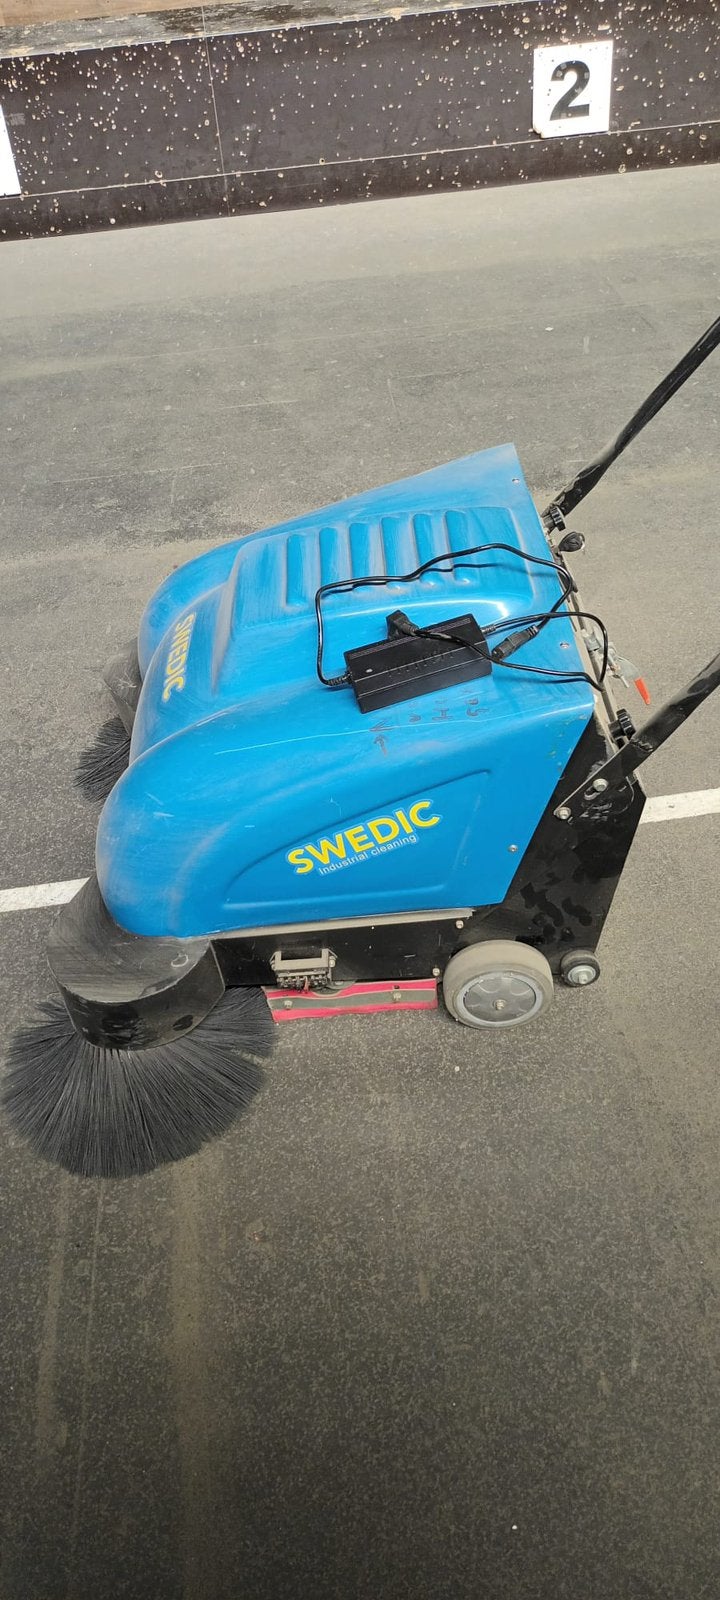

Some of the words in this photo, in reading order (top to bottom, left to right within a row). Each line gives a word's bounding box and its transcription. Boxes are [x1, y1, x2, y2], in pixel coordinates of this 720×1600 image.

[549, 60, 591, 121] 2
[162, 613, 196, 702] SWEDIC
[286, 800, 442, 875] SWEDIC
[318, 851, 370, 876] Industrial
[370, 834, 418, 857] cleaning
